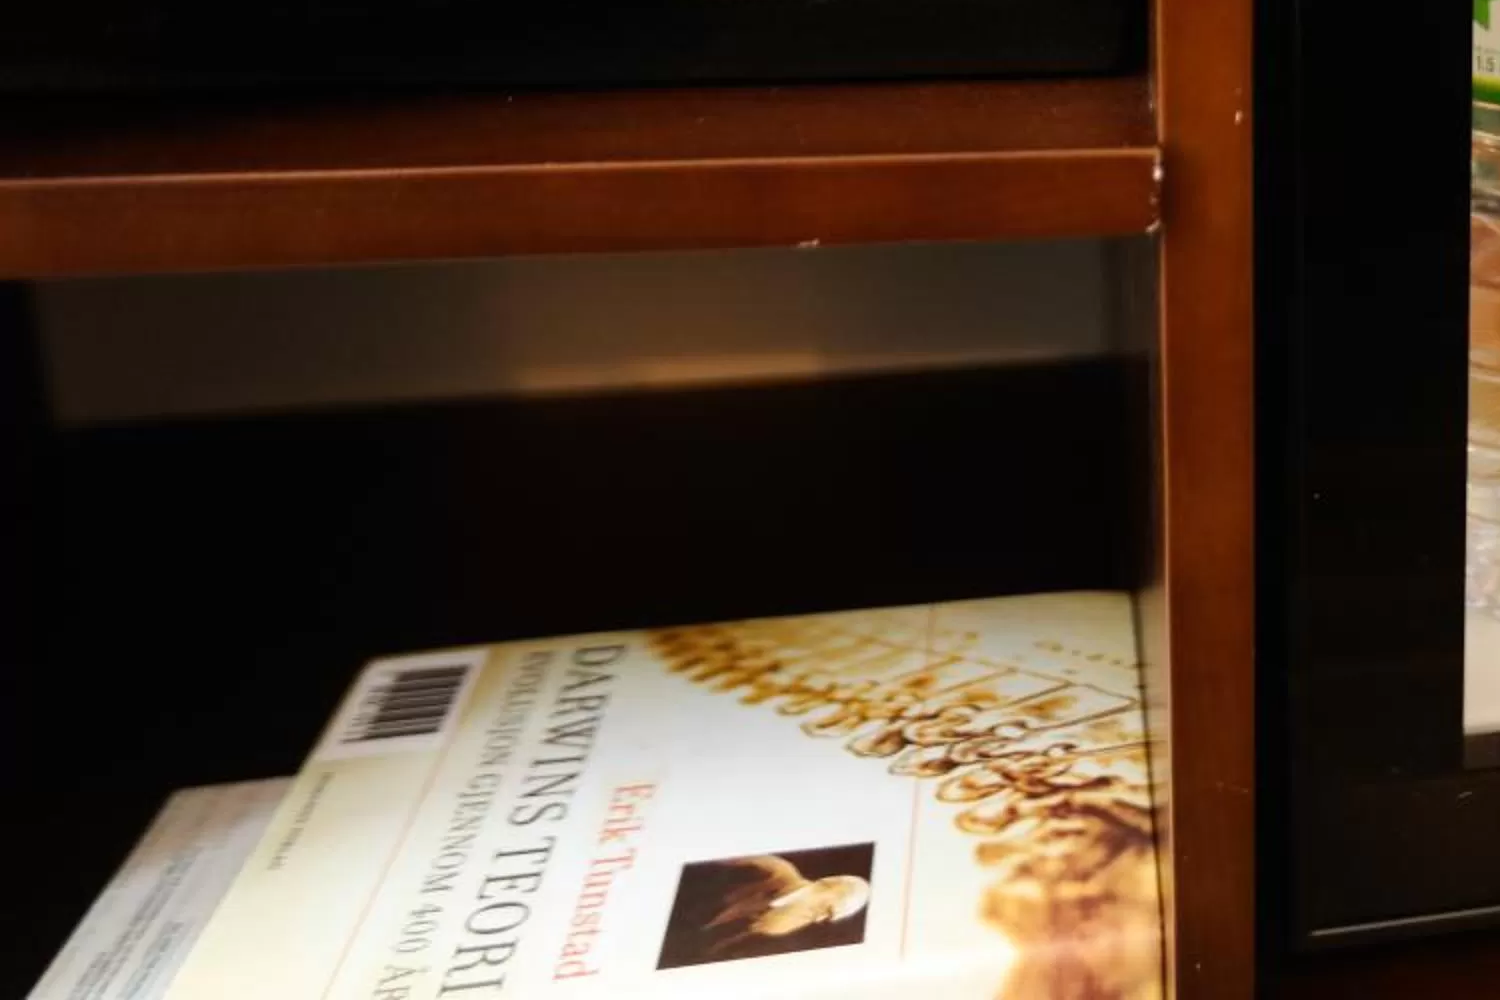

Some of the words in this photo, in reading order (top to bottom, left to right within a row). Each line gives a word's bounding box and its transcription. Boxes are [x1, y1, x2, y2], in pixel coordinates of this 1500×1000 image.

[506, 644, 625, 826] DARWINS
[420, 772, 501, 895] GJENNOM
[599, 782, 657, 845] Erik
[395, 903, 442, 953] 400
[436, 835, 558, 998] TEORI
[551, 846, 639, 981] Tunstad
